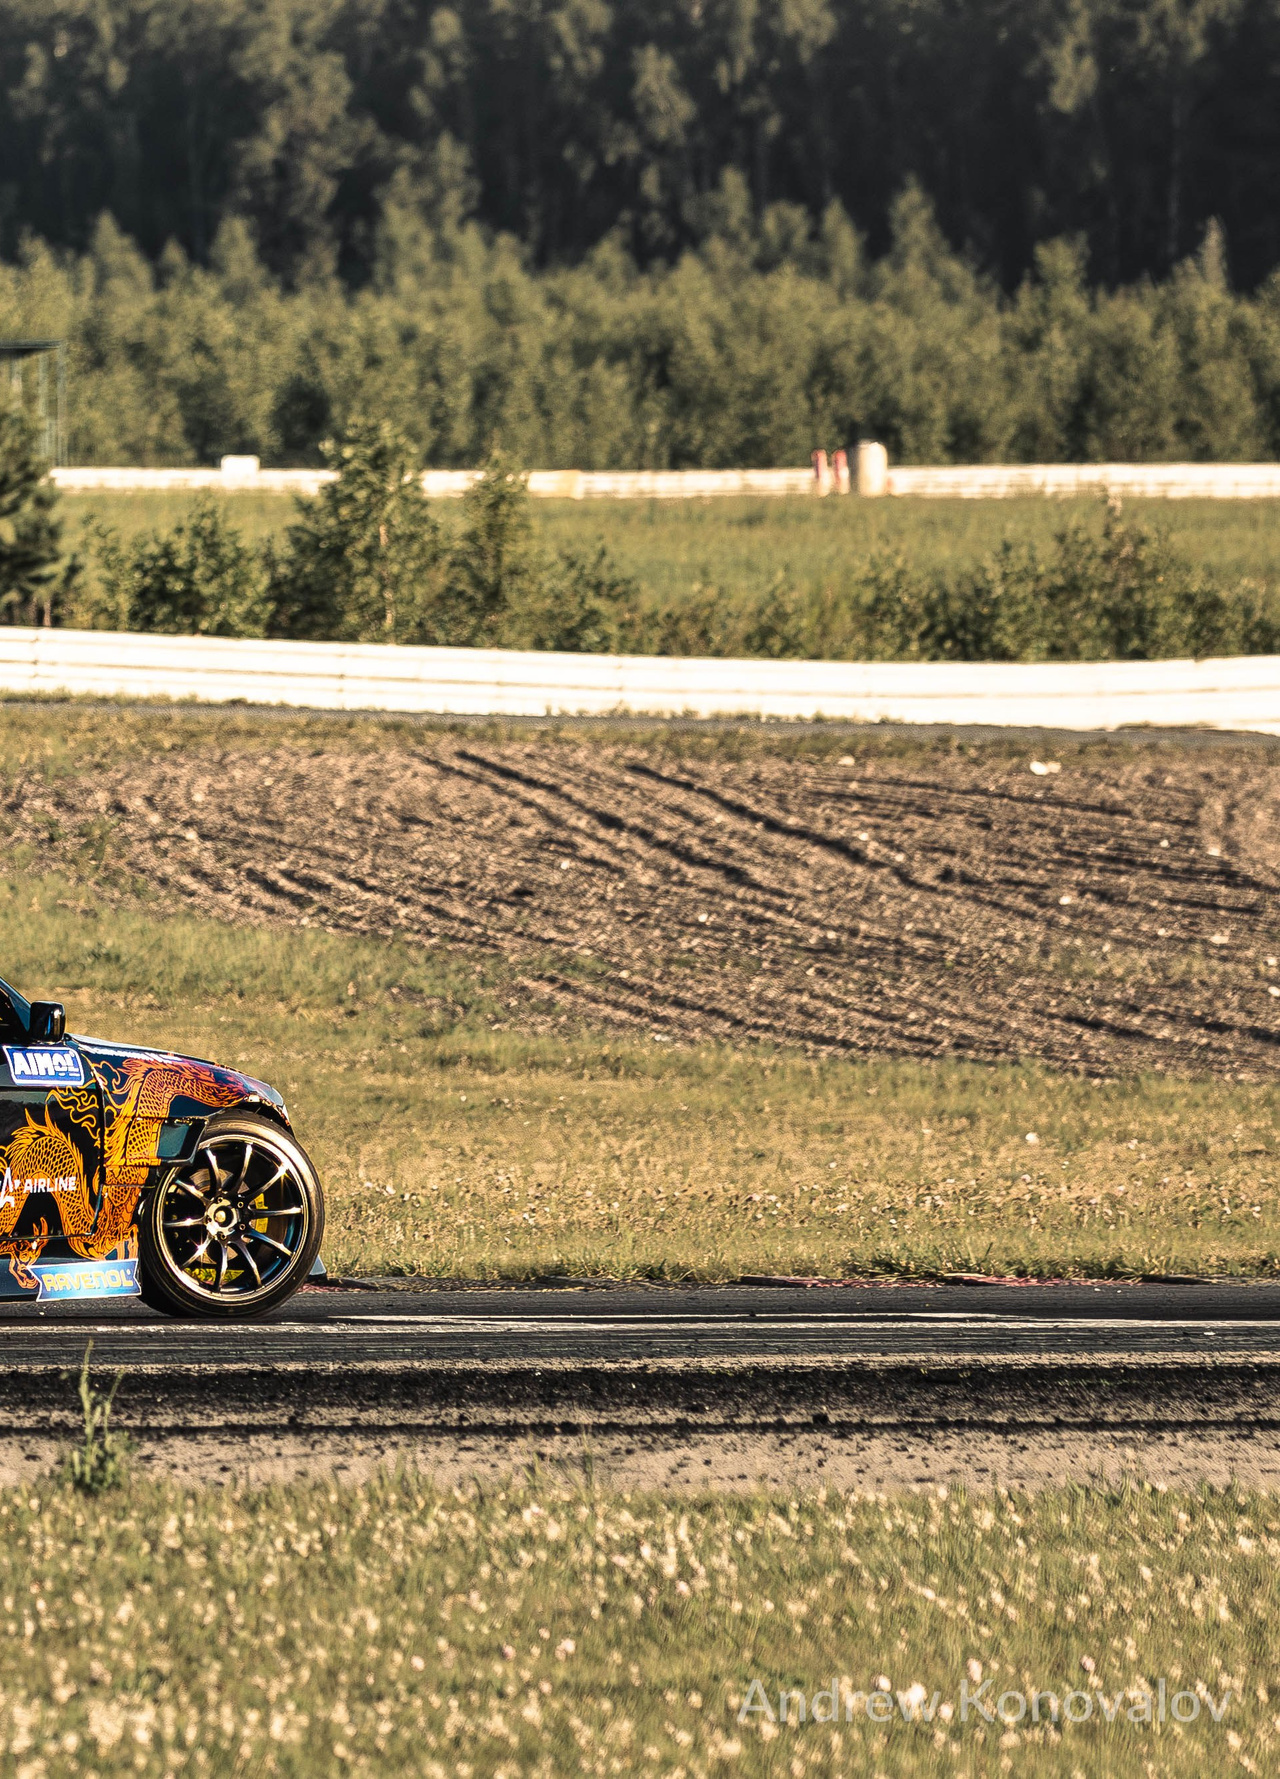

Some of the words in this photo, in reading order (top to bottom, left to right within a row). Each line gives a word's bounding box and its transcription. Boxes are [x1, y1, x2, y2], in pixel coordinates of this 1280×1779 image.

[13, 1051, 80, 1077] AIMOL
[23, 1176, 77, 1194] AIRLINE
[41, 1269, 134, 1292] RAVENOL
